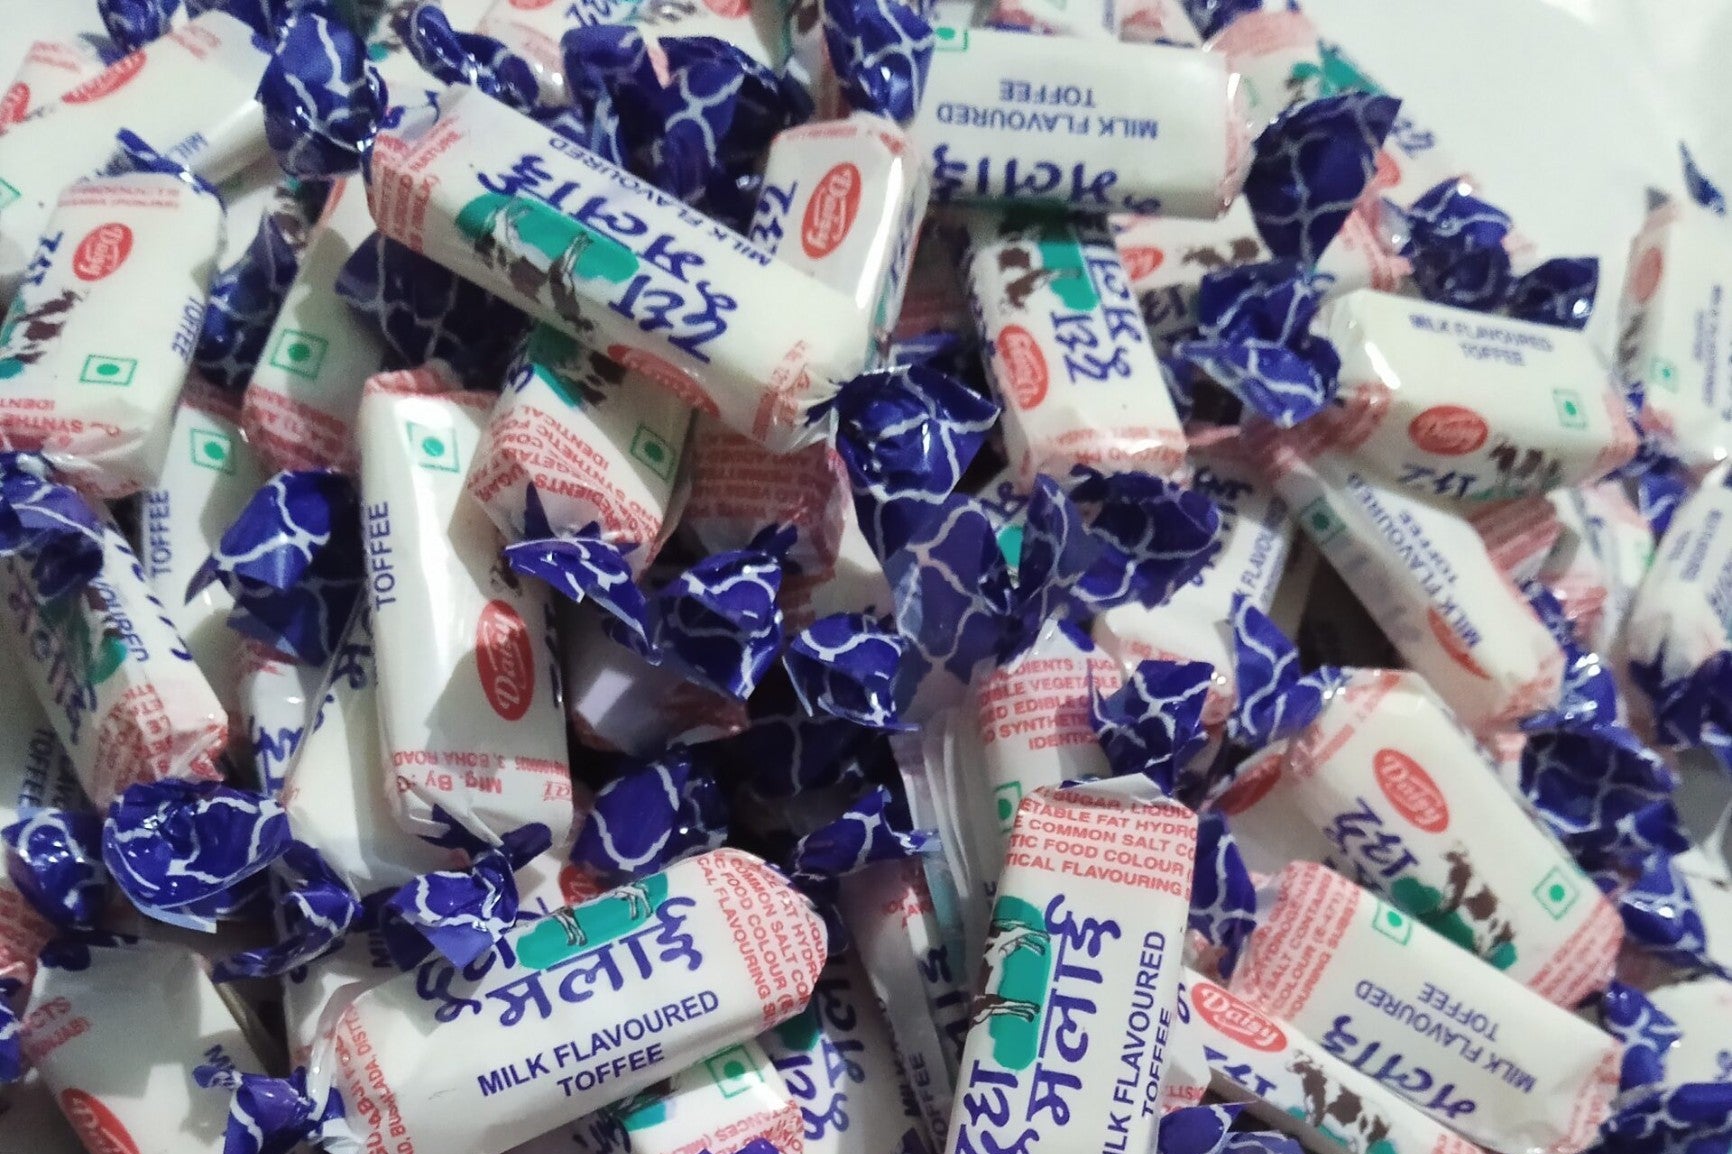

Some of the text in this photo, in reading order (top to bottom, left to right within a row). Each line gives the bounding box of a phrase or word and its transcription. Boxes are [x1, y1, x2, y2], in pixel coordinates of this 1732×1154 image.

[936, 103, 1159, 139] MILK FLAVOURED
[999, 79, 1096, 108] TOFFEE
[477, 154, 705, 283] मलाई
[708, 226, 772, 267] MILK
[608, 275, 738, 364] दूध
[147, 489, 171, 579] TOFFEE
[373, 500, 395, 611] TOFFEE
[490, 604, 530, 716] Daisy
[1029, 819, 1117, 844] COMMON
[1121, 834, 1171, 852] SALT
[1044, 839, 1099, 859] FOOD
[1104, 849, 1185, 877] COLOUR
[1097, 814, 1131, 829] FAT
[730, 857, 798, 964] COMMON SALT
[1061, 860, 1183, 896] FLAVOURING
[486, 896, 705, 1028] मलाई
[714, 886, 772, 1000] FLAVOURING
[720, 871, 788, 990] FOOD COLOUR
[477, 989, 720, 1097] MILK FLAVOURED
[1026, 893, 1121, 1126] मलाई
[1113, 930, 1166, 1106] FLAVOURED
[1195, 985, 1280, 1047] Daisy
[1354, 979, 1538, 1095] MILK FLAVOURED
[1417, 981, 1501, 1042] TOFFEE
[556, 1044, 666, 1098] TOFFEE
[1141, 1007, 1173, 1119] TOFFEE
